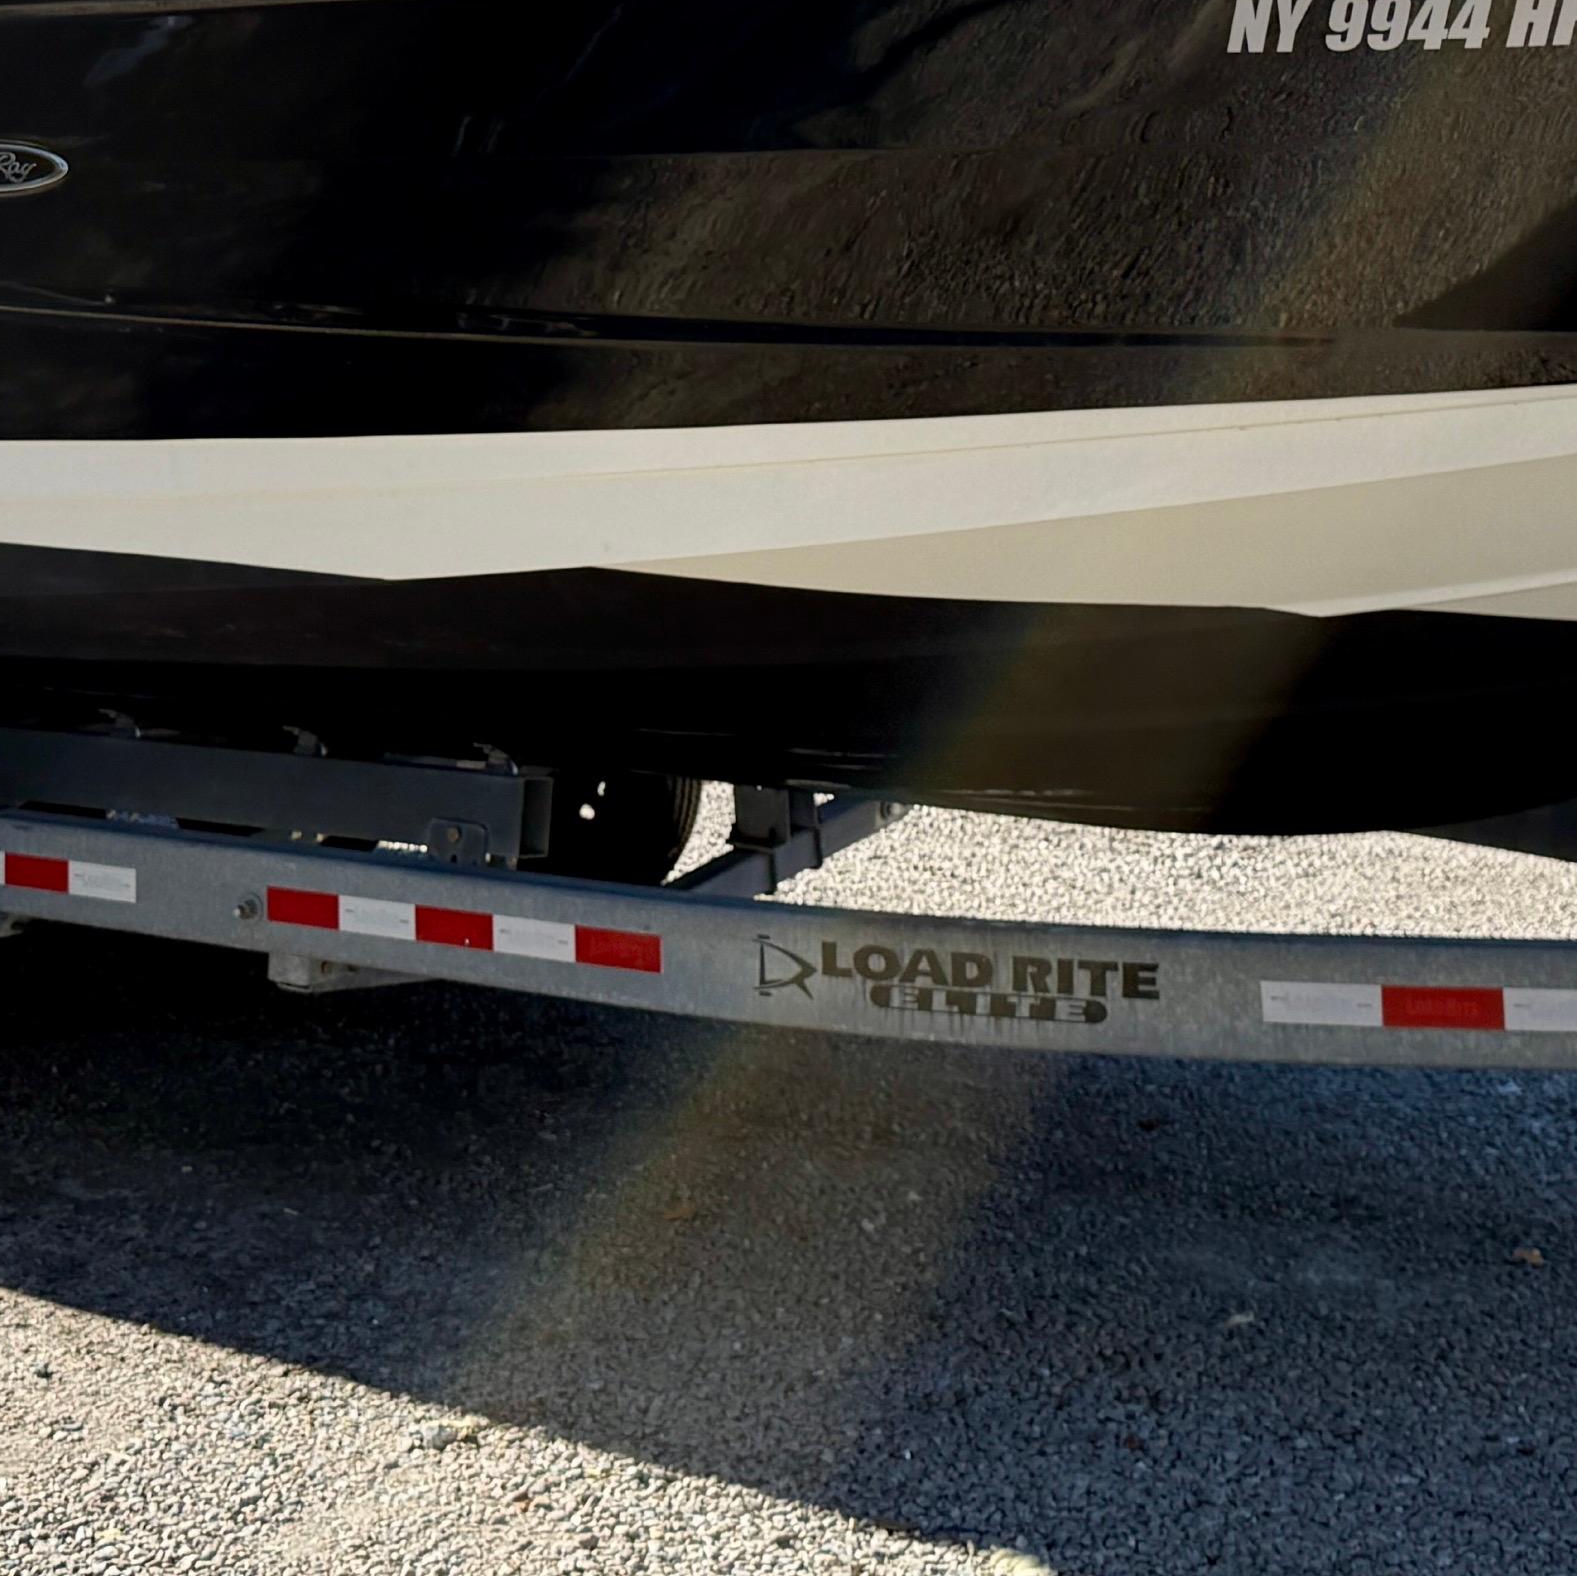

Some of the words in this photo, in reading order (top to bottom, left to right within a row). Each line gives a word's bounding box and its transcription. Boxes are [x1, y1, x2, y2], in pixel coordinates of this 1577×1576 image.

[820, 941, 994, 987] LOAD
[1010, 954, 1160, 999] RITE
[888, 985, 1090, 1023] ELITE
